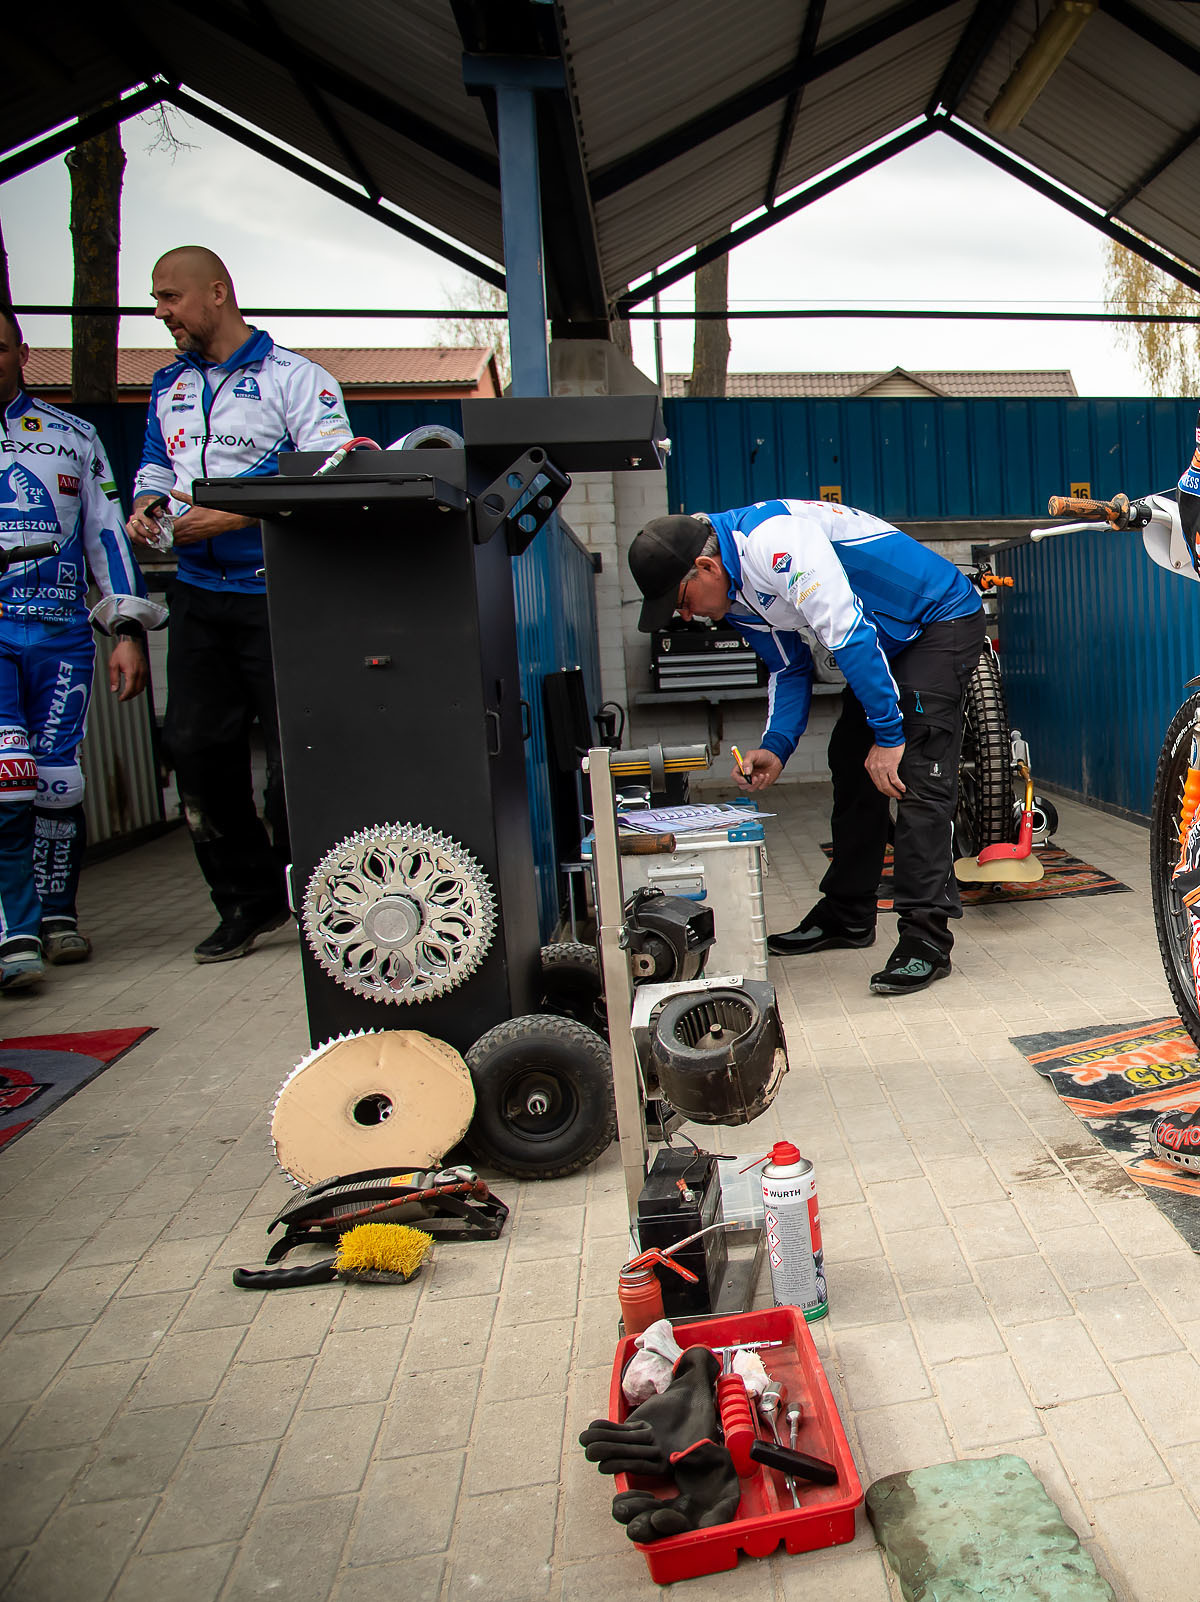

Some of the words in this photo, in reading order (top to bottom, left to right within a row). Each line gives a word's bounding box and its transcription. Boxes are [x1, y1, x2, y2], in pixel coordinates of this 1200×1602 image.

[190, 434, 256, 449] TEXOM
[0, 439, 78, 460] EXOM
[822, 492, 839, 503] 15
[1073, 488, 1089, 500] 16
[12, 586, 77, 601] NEXORIS
[40, 660, 73, 752] EXTRANS
